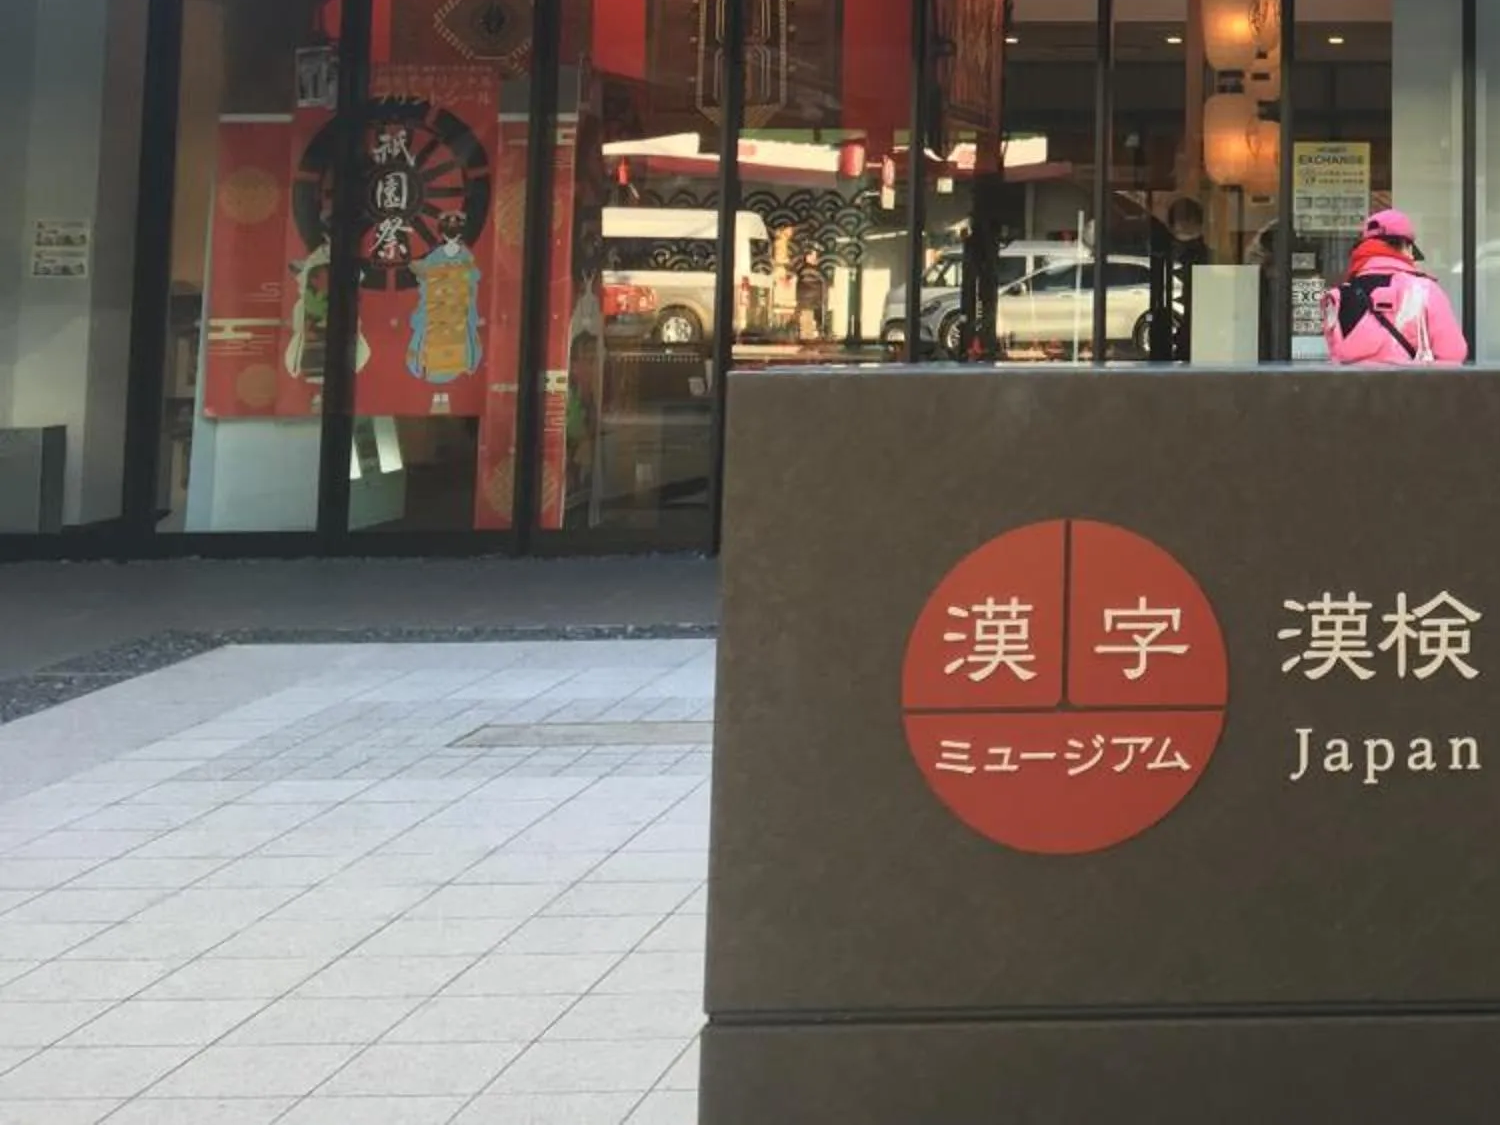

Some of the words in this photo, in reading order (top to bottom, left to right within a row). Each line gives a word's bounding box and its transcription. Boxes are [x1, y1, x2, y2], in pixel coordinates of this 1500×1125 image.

[1277, 589, 1483, 680] 漢検
[935, 734, 1192, 776] ミュージアム
[1290, 727, 1482, 784] Japan
